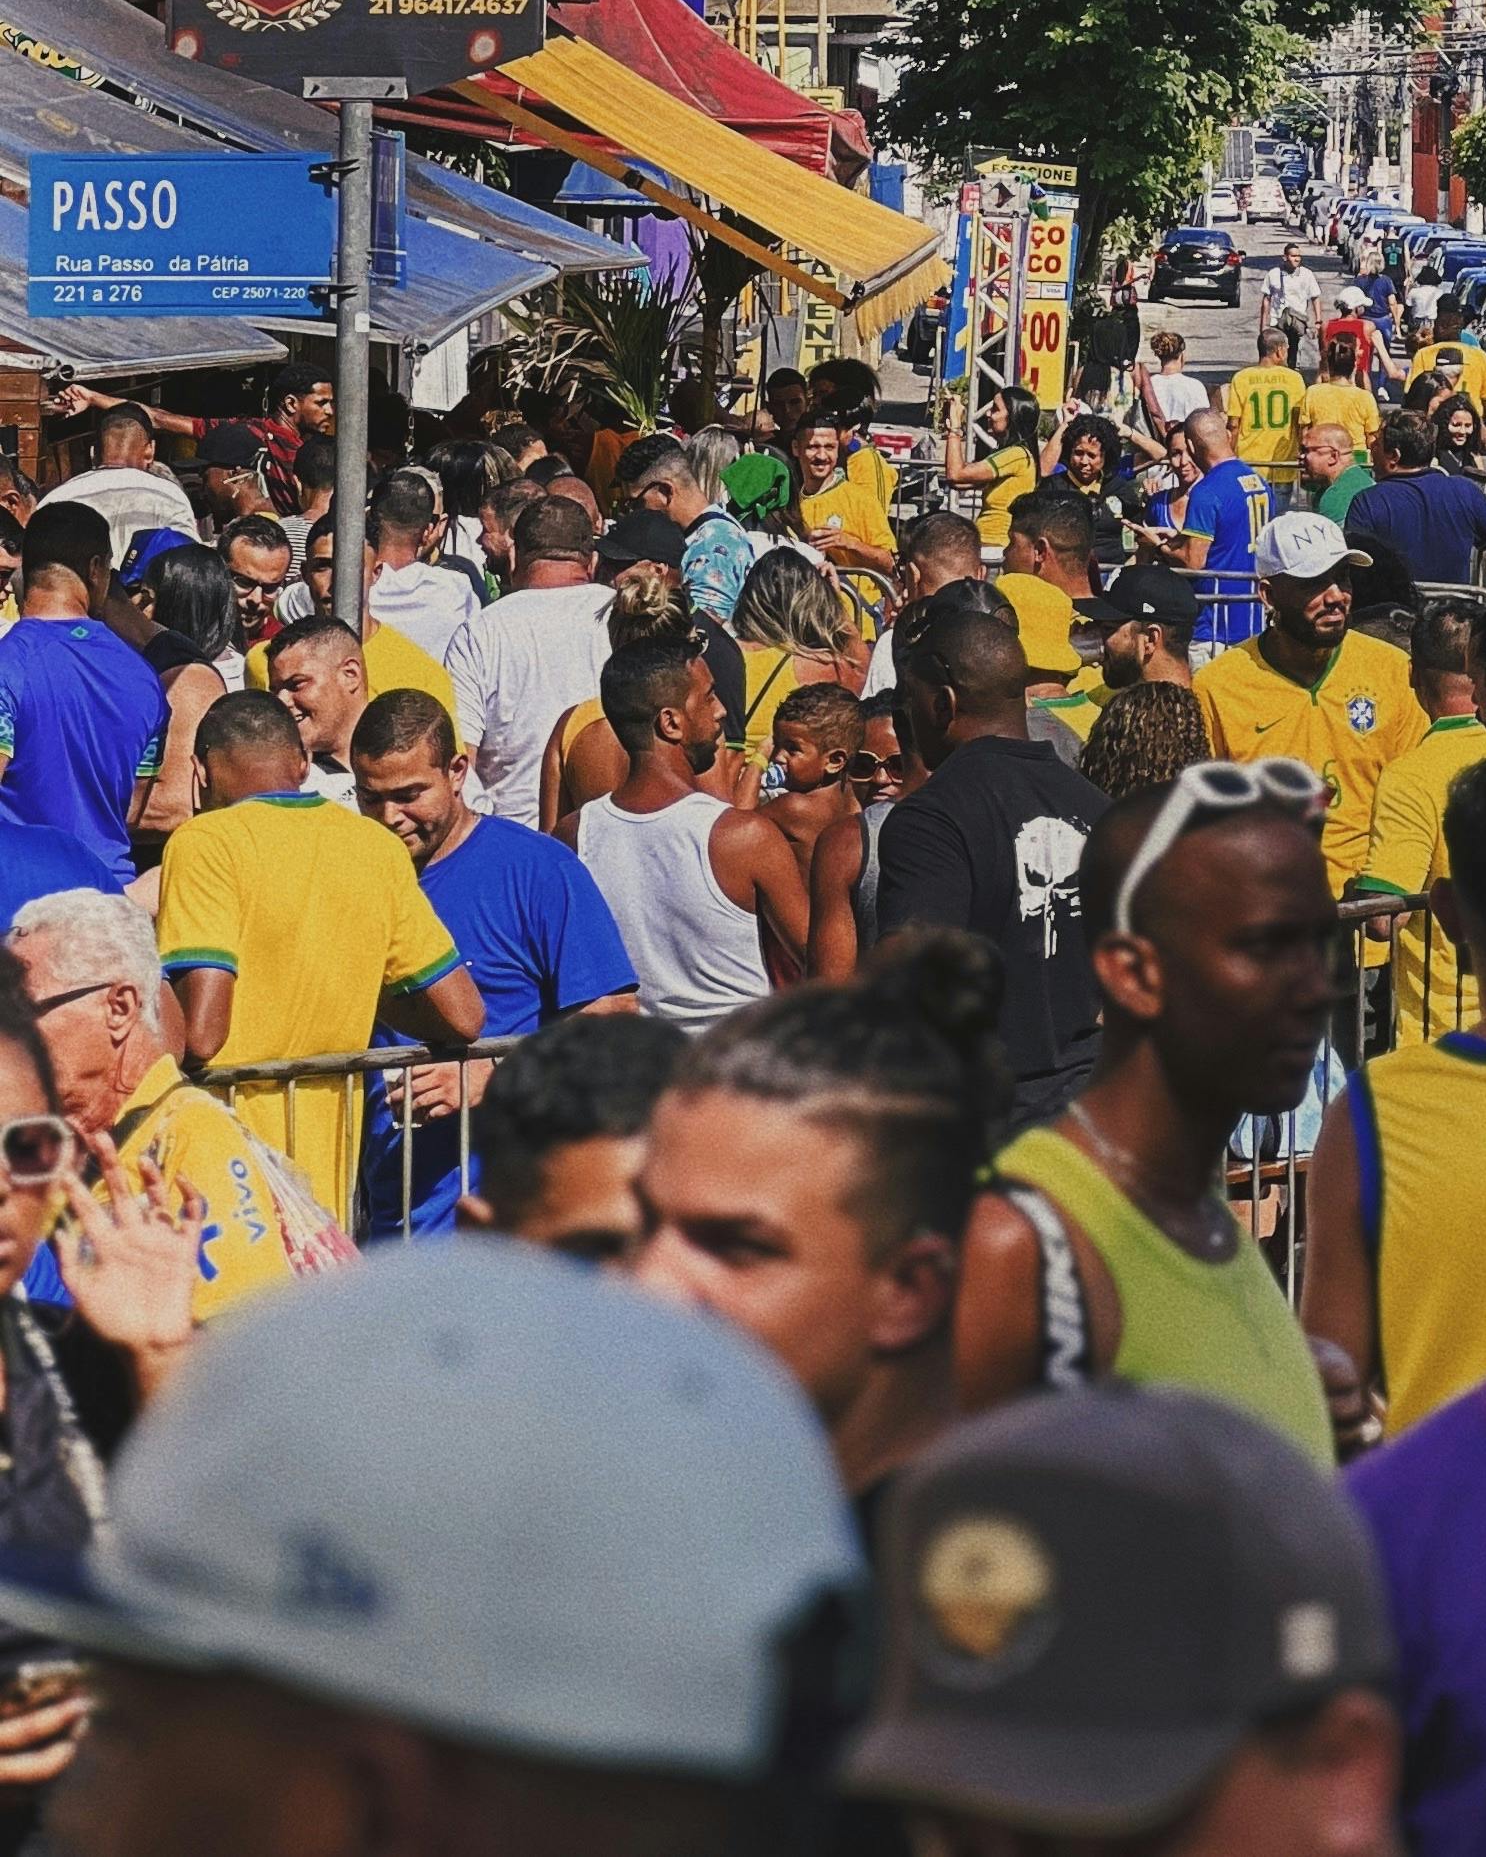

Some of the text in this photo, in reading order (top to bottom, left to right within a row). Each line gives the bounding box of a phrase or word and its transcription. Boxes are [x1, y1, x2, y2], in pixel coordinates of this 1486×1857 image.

[53, 179, 178, 232] PASSO
[55, 254, 249, 273] Rua Passo da Pátria
[53, 284, 305, 302] 221 a 276 CEP 25071-220
[1249, 389, 1290, 430] 10
[230, 1158, 267, 1243] vivo
